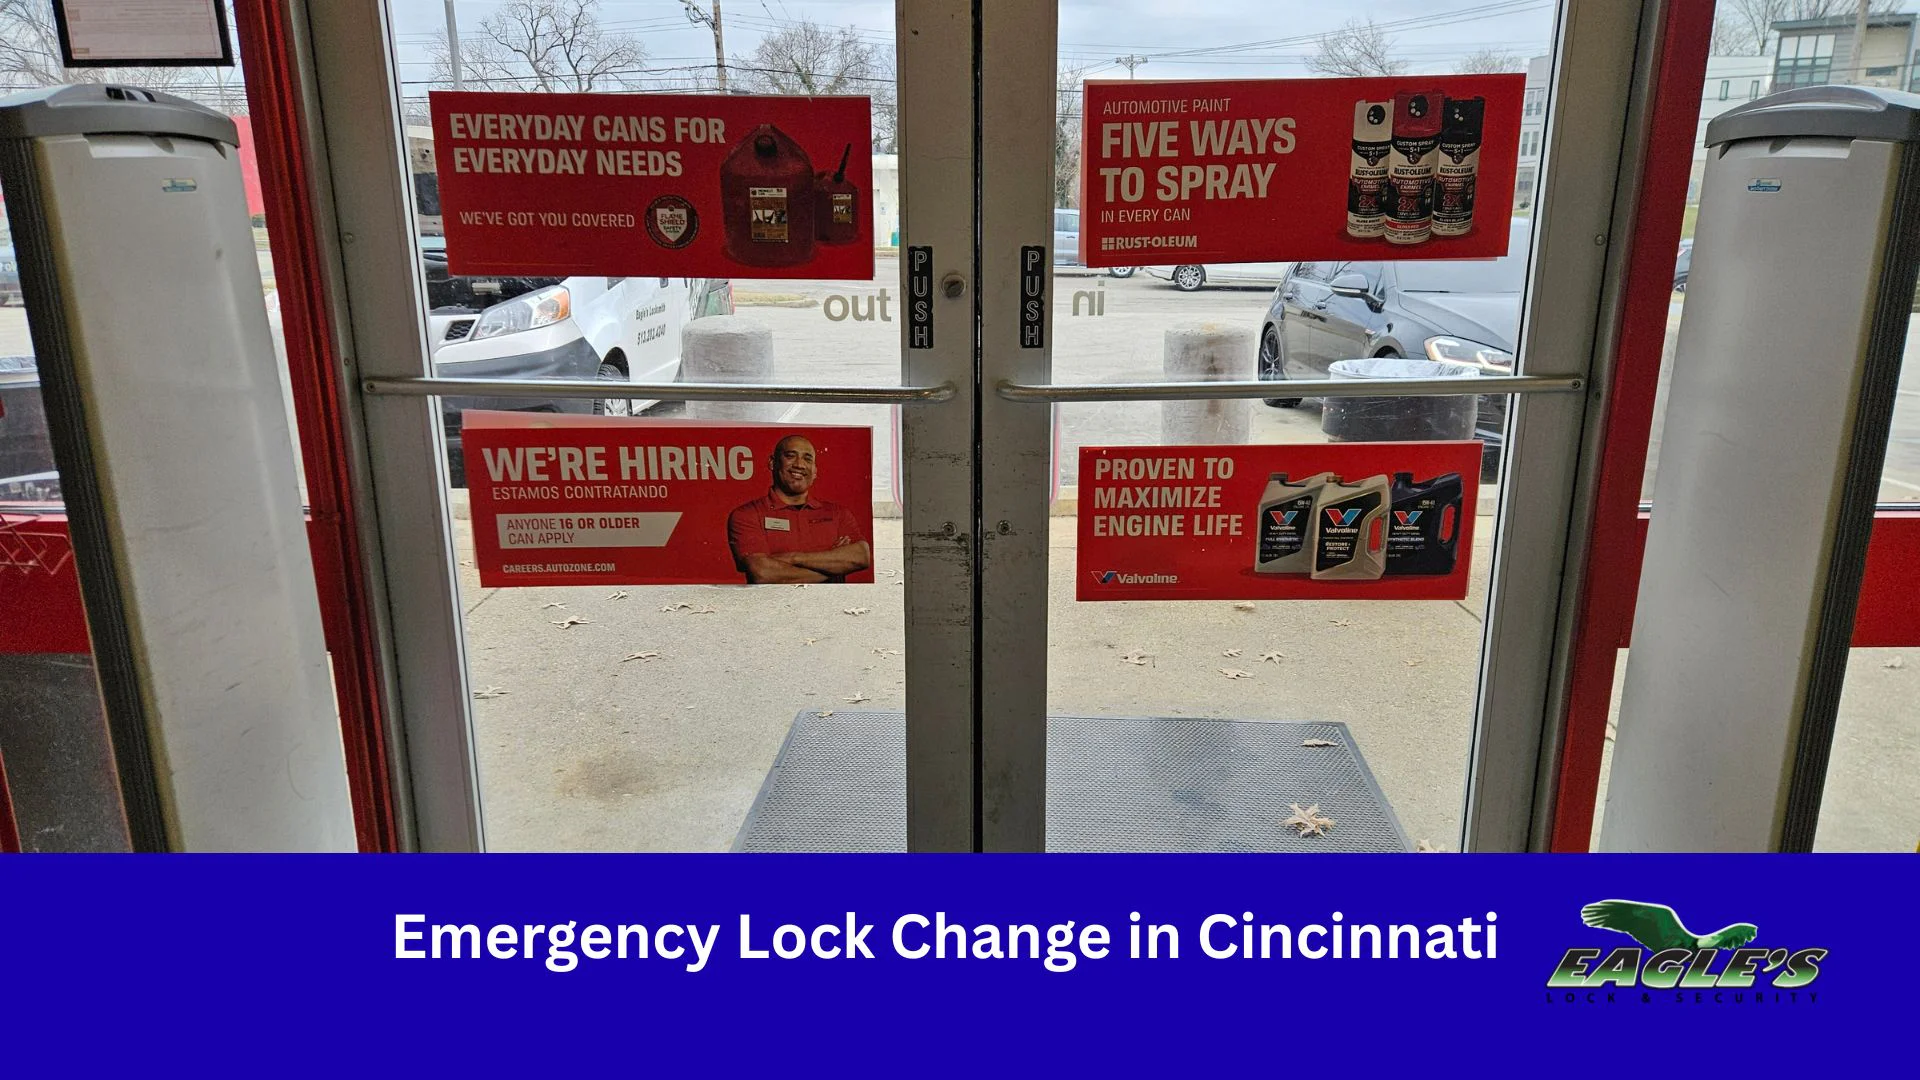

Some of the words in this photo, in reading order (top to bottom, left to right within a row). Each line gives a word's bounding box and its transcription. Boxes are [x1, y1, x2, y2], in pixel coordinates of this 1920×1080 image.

[1103, 100, 1188, 115] AUTOMOTIVE
[1192, 98, 1231, 112] PAINT
[450, 113, 585, 141] EVERYDAY
[593, 116, 666, 143] CANS
[675, 117, 726, 144] FOR
[1102, 121, 1179, 158] FIVE
[1190, 117, 1296, 156] WAYS
[454, 147, 588, 175] EVERYDAY
[597, 150, 683, 177] NEEDS
[1394, 167, 1432, 175] RUST-OLEUM
[1100, 166, 1145, 203] TO
[1156, 163, 1277, 201] SPRAY
[460, 211, 504, 225] WE'VE
[508, 212, 534, 226] GOT
[539, 213, 567, 226] YOU
[572, 213, 635, 228] COVERED
[1101, 210, 1114, 223] IN
[1118, 209, 1159, 222] EVERY
[1163, 208, 1191, 221] CAN
[1115, 235, 1197, 250] RUST-OLEUM
[823, 288, 892, 322] out
[913, 250, 928, 347] PUSH
[1025, 250, 1040, 347] PUSH
[482, 446, 608, 482] WE'RE
[619, 446, 754, 480] HIRING
[1095, 458, 1195, 480] PROVEN
[1203, 457, 1234, 479] TO
[492, 487, 560, 500] ESTAMOS
[564, 485, 668, 499] CONTRATANDO
[1094, 486, 1222, 508] MAXIMIZE
[507, 518, 556, 530] ANYONE
[559, 518, 573, 529] 16
[578, 518, 595, 529] OR
[600, 518, 640, 528] OLDER
[1094, 515, 1185, 537] ENGINE
[1194, 515, 1242, 535] LIFE
[508, 533, 533, 544] CAN
[538, 533, 574, 544] APPLY
[503, 563, 615, 573] CAREERS.AUTOZONE.COM
[1117, 574, 1178, 584] Valvoline
